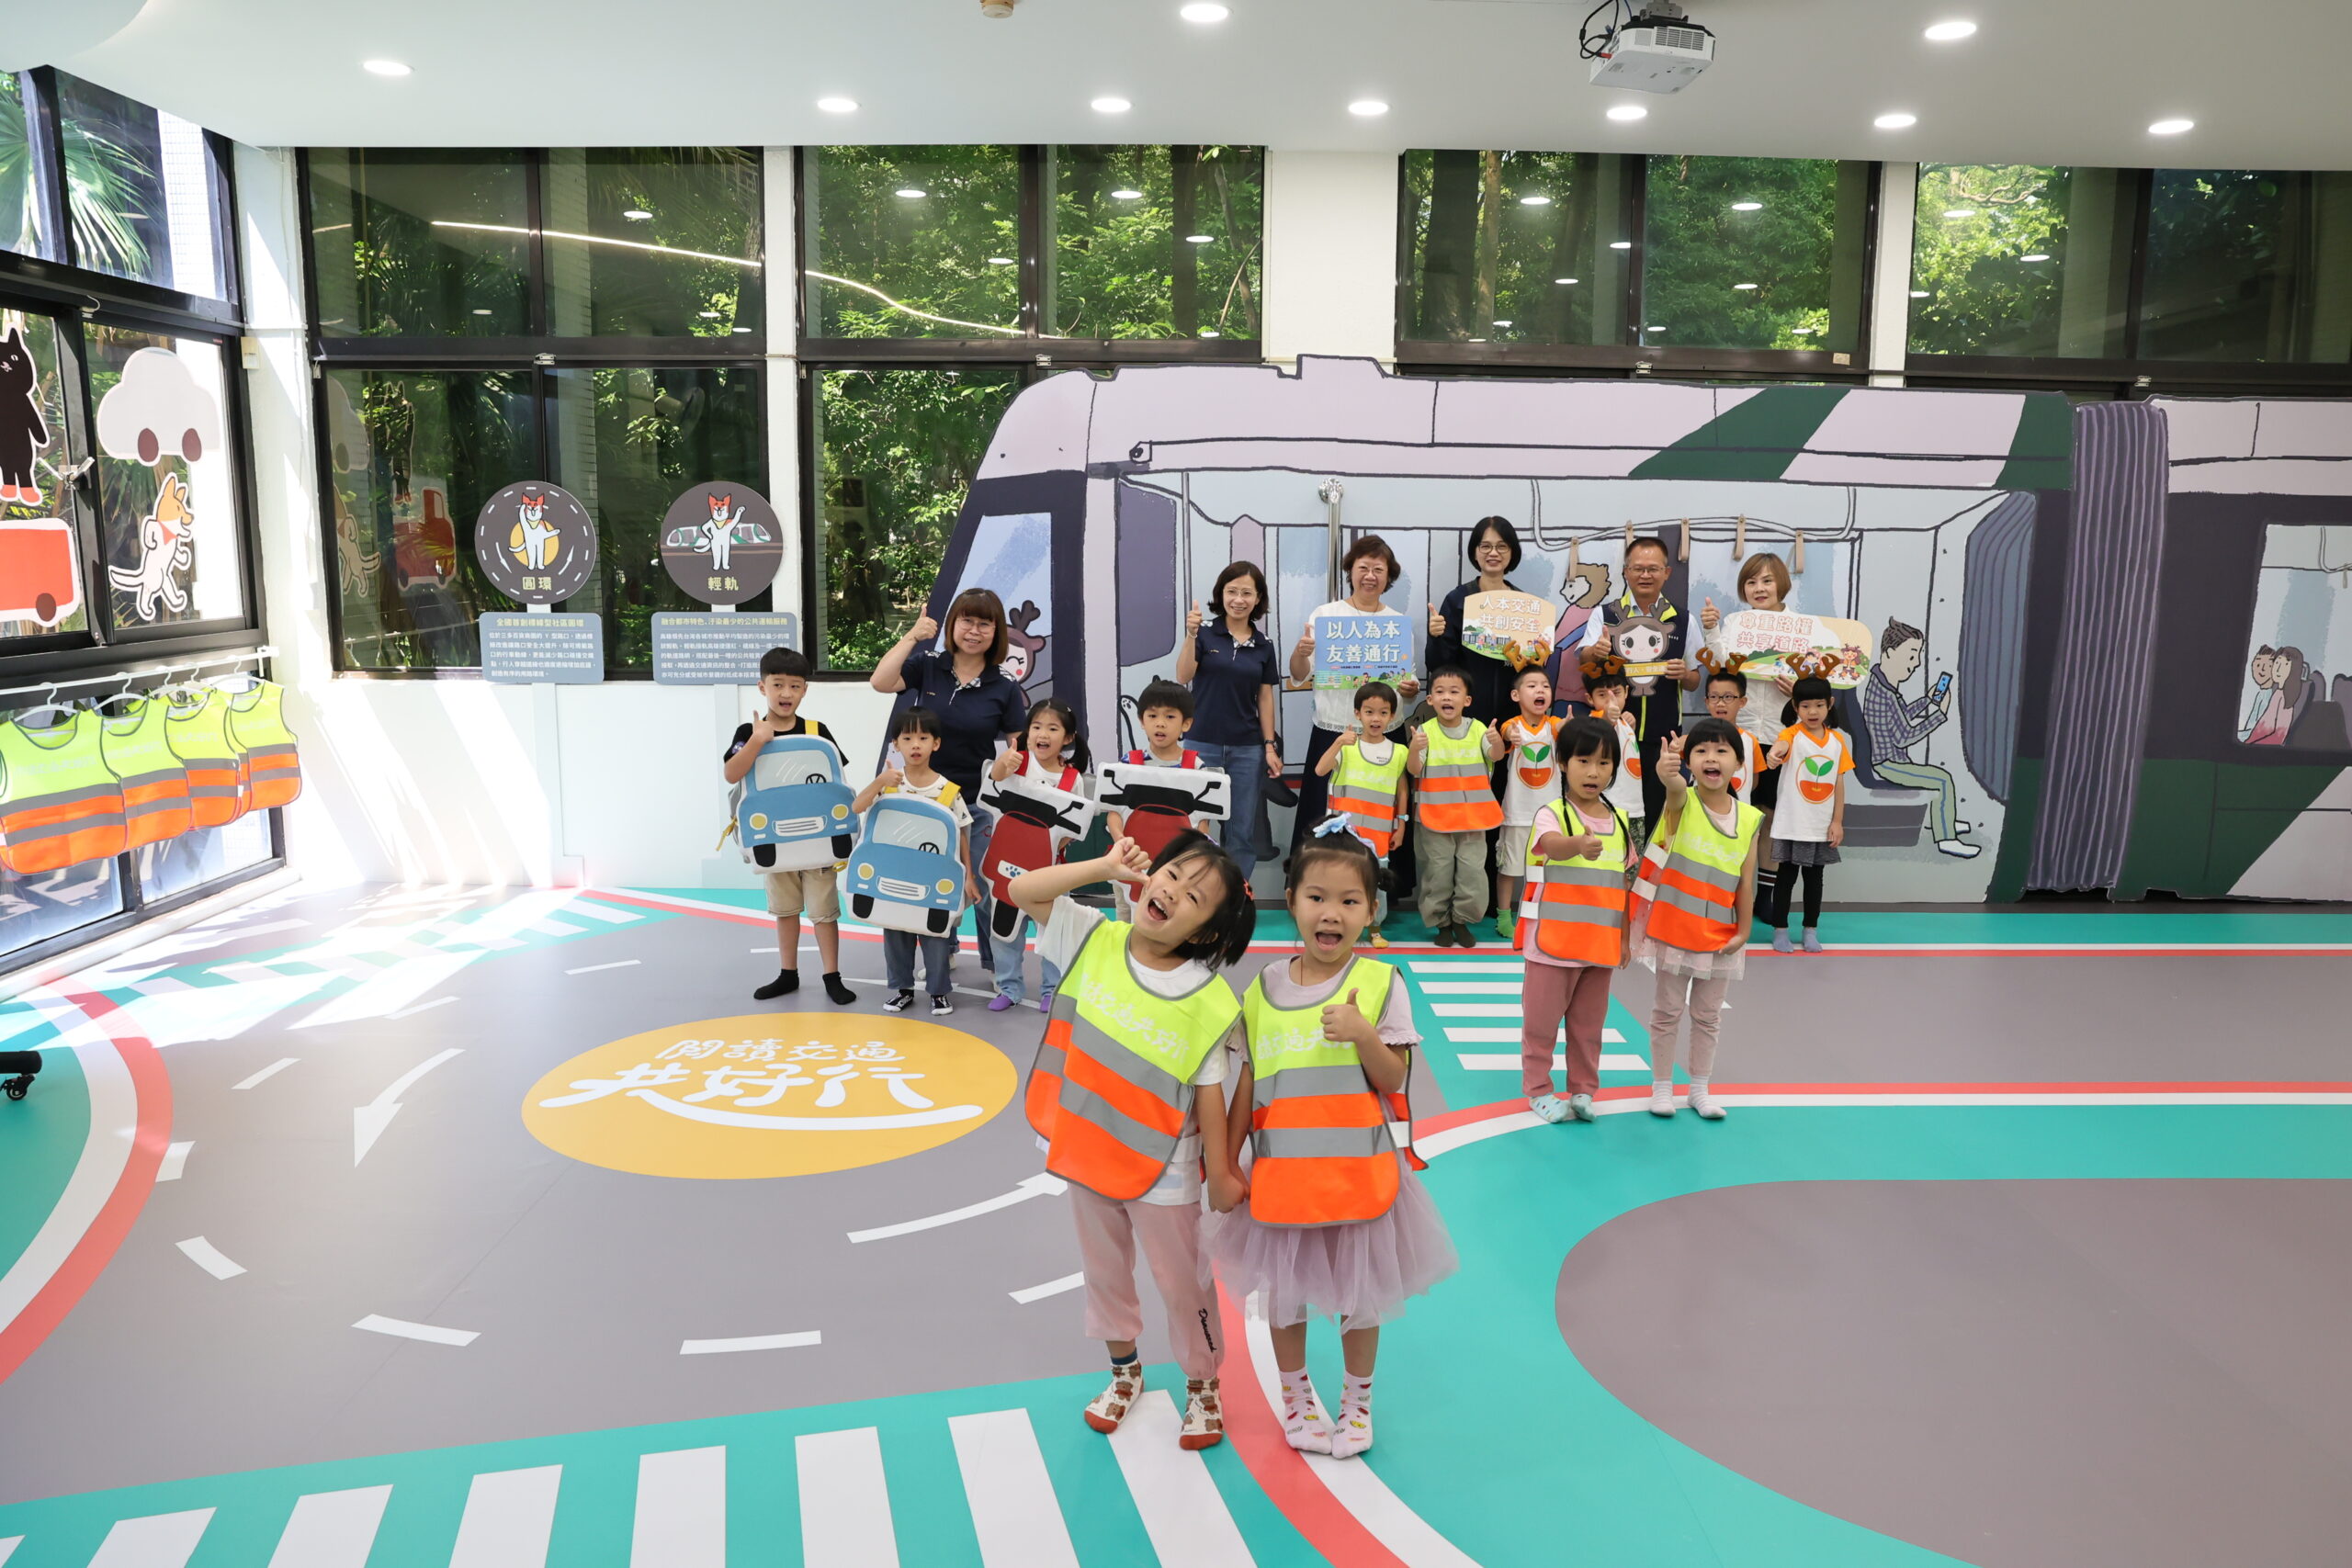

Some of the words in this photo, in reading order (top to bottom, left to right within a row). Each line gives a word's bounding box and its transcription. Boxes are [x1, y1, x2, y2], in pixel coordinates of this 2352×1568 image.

[522, 576, 552, 591] 圓環
[707, 576, 739, 591] 輕軌
[1482, 594, 1542, 615] 人本交通
[1326, 620, 1400, 639] 以人為本
[1480, 614, 1540, 633] 共創安全
[1740, 612, 1814, 636] 尊重路權
[1736, 631, 1810, 653] 共享道路
[1326, 644, 1400, 663] 友善通行
[655, 1039, 906, 1063] 閱讀交通
[538, 1063, 984, 1131] 共好行
